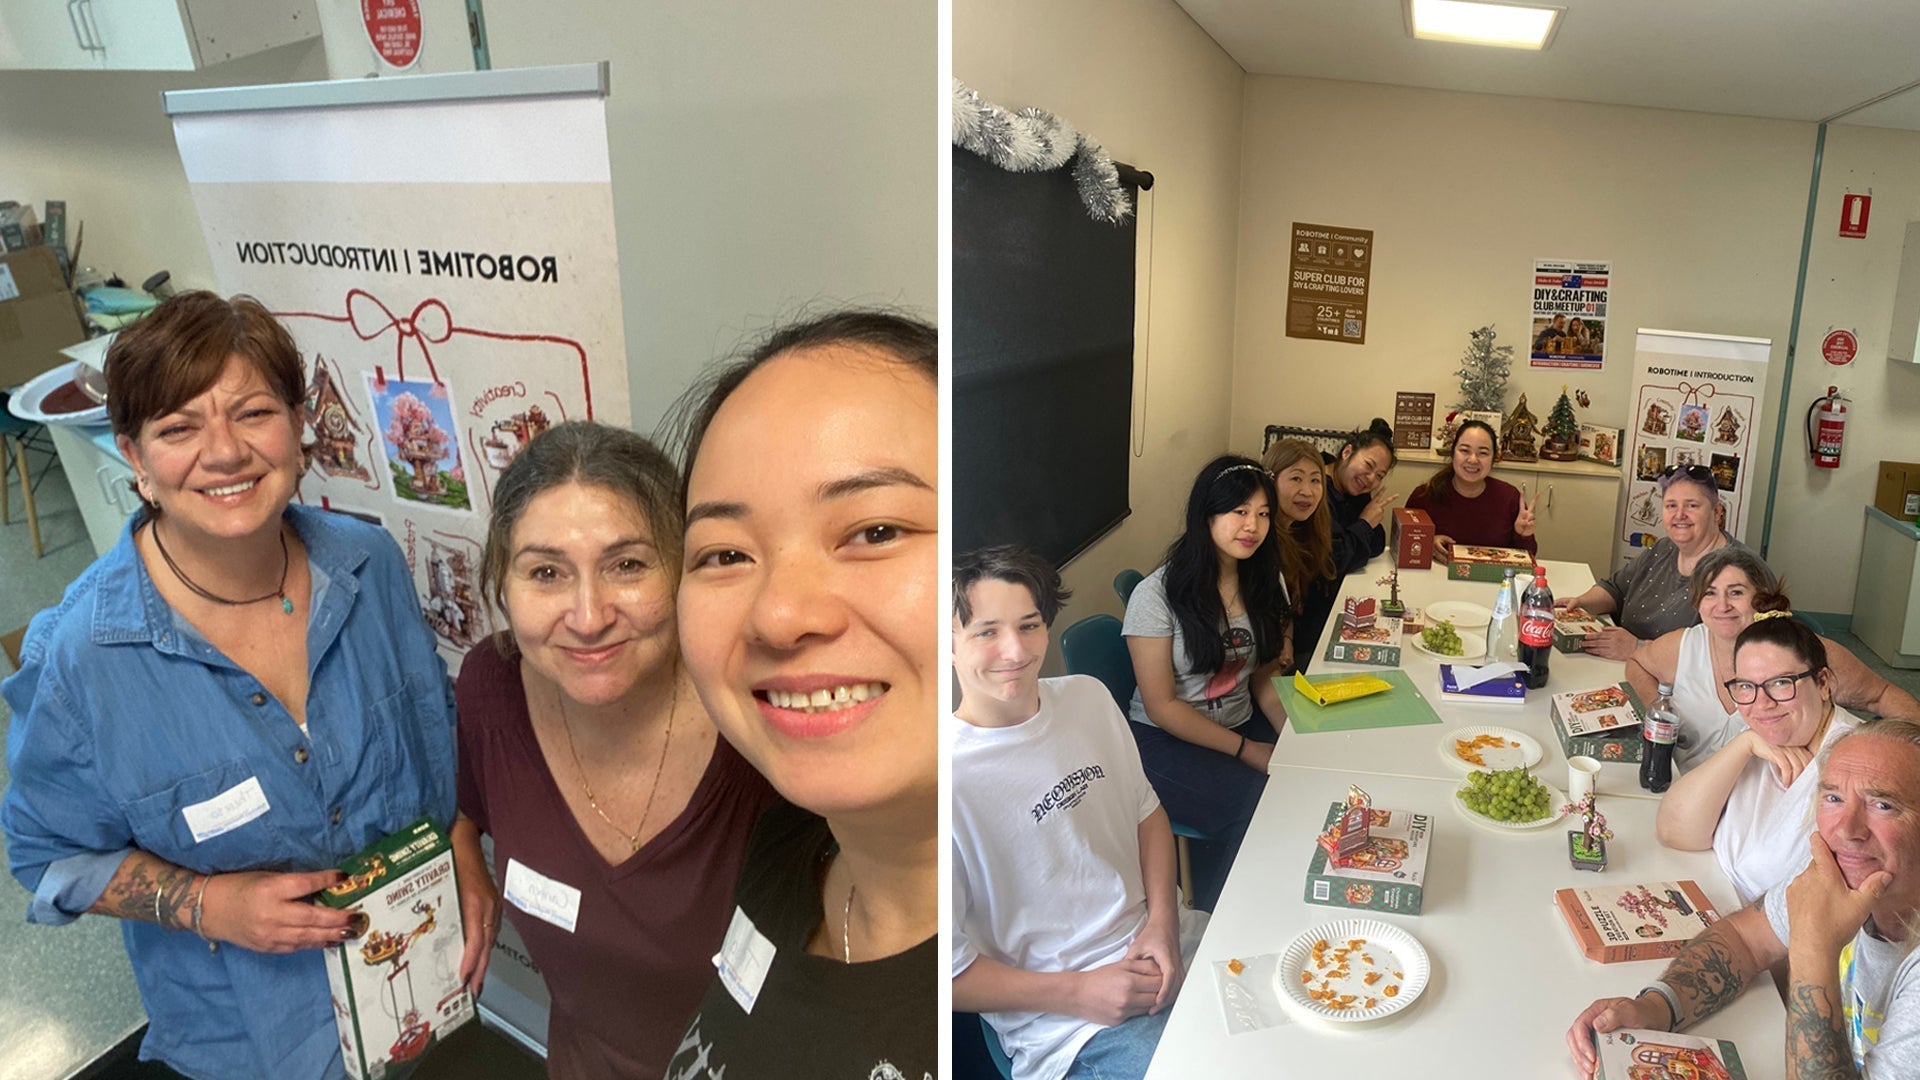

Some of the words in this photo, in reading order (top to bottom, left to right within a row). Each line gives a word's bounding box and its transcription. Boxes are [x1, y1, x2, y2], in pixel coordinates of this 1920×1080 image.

[1296, 229, 1329, 240] ROBOTIME
[1333, 233, 1368, 244] Community
[1293, 270, 1322, 283] SUPER
[1323, 273, 1346, 286] CLUB
[1347, 276, 1365, 287] FOR
[1340, 286, 1364, 296] LOVERS
[1533, 301, 1554, 310] CLUB
[1554, 302, 1586, 312] MEETUP
[1586, 303, 1595, 312] 01
[1647, 366, 1689, 377] ROBOTIME
[1693, 370, 1754, 383] INTRODUCTION
[1413, 814, 1428, 833] DIY
[1591, 905, 1612, 931] PUZZLE
[1606, 931, 1618, 941] 3D
